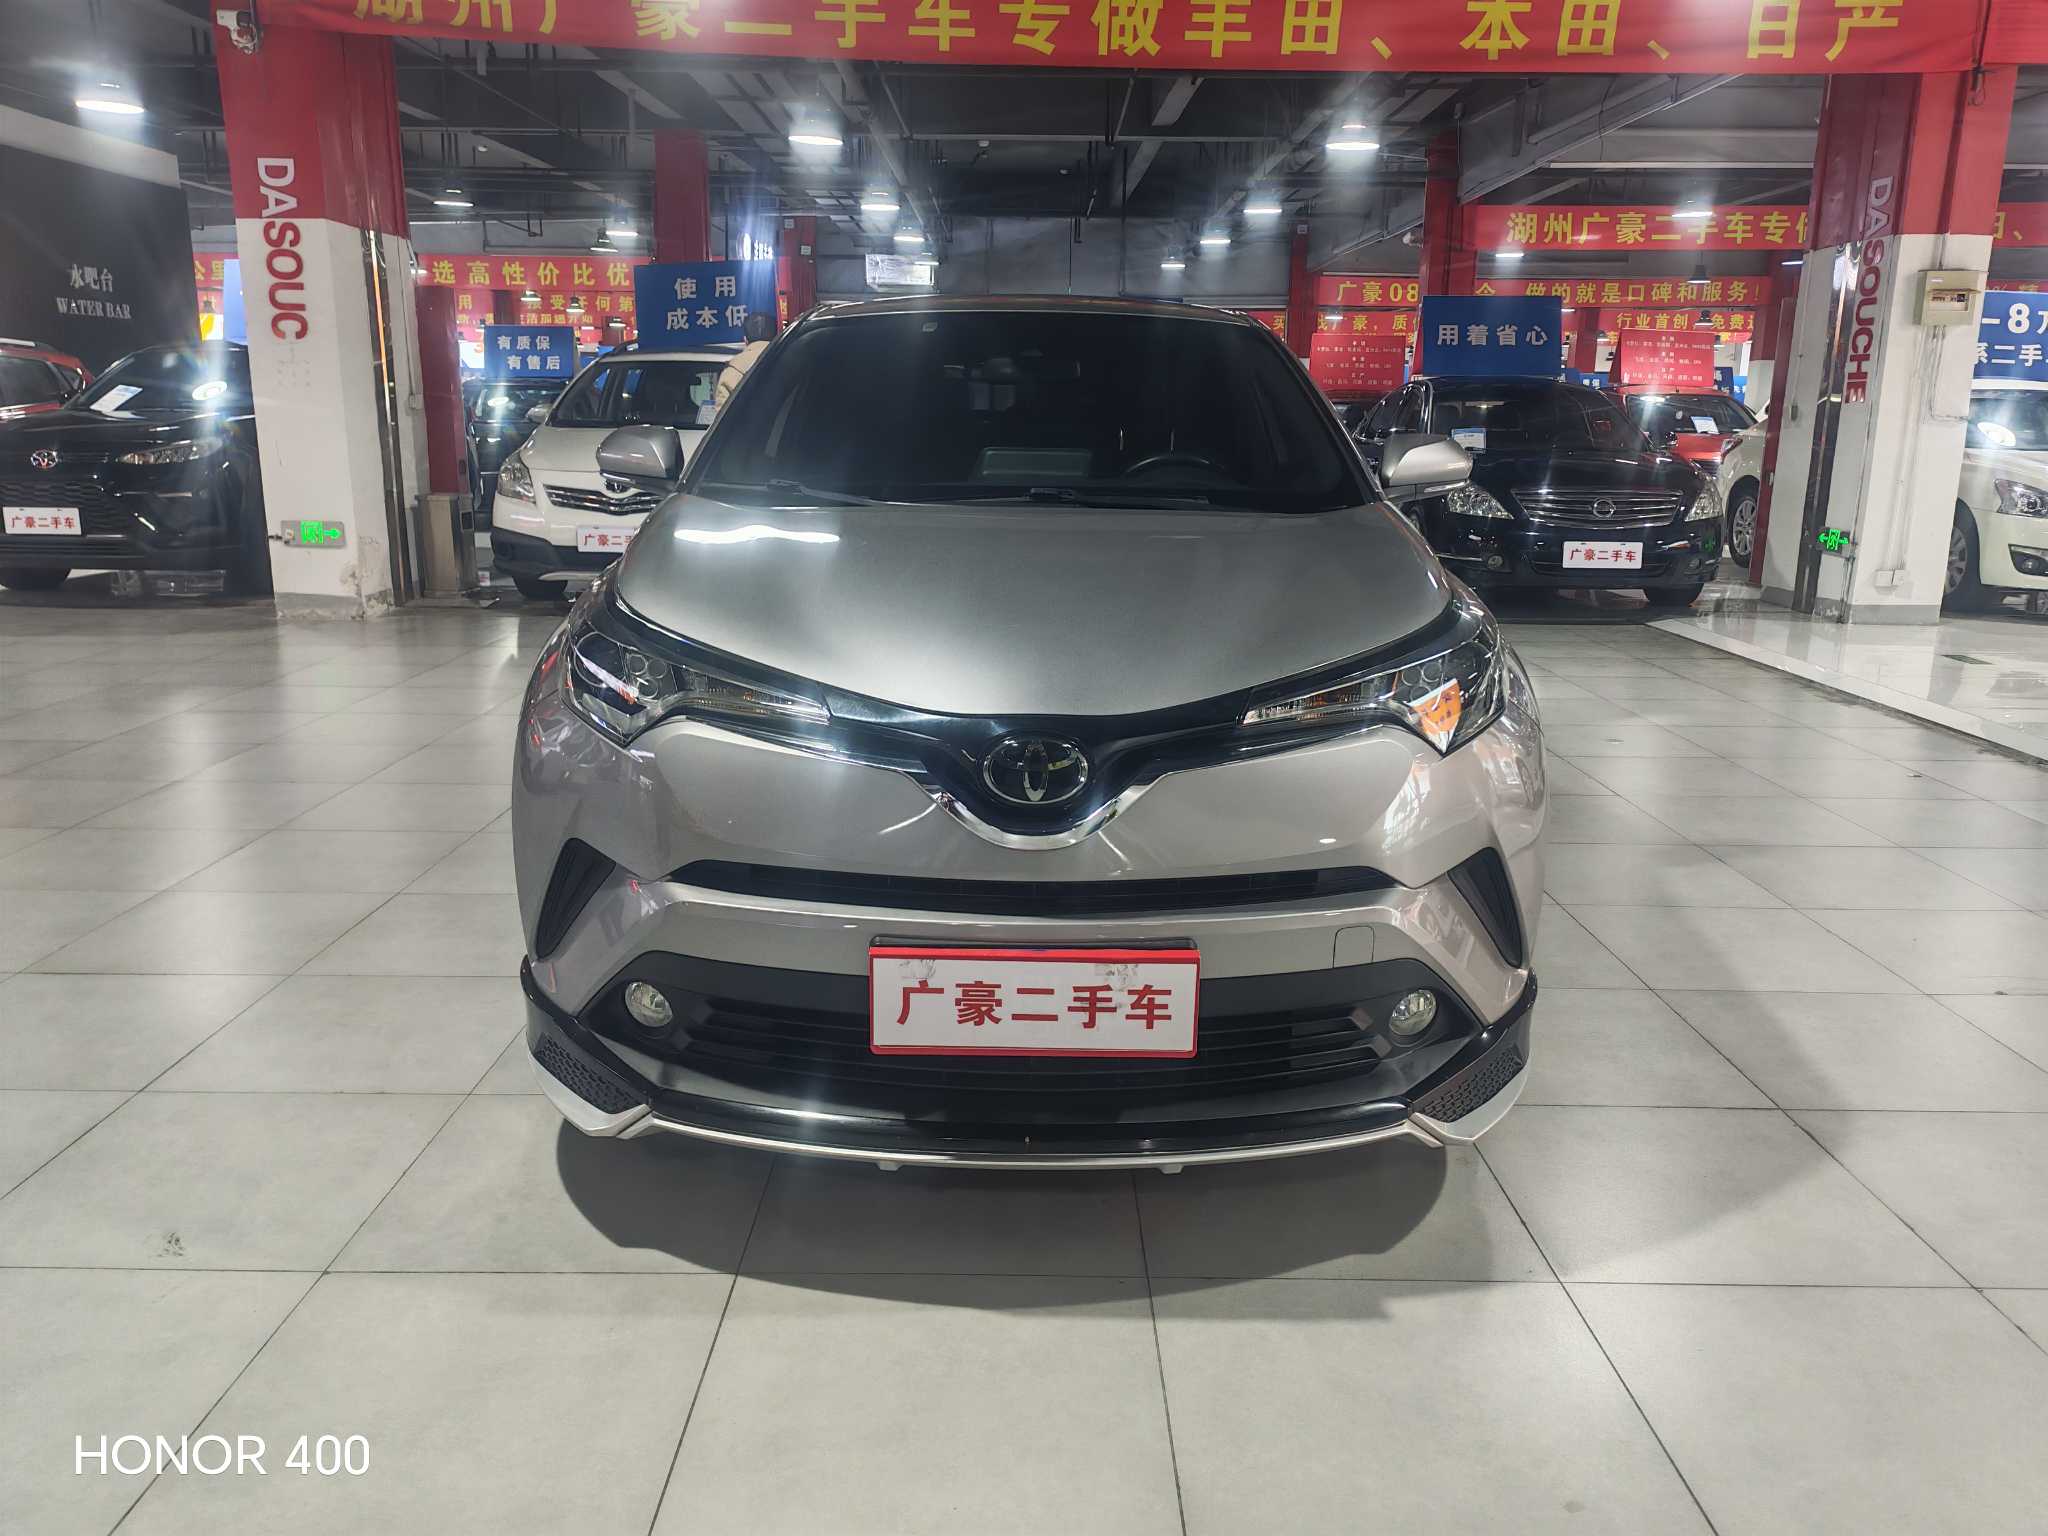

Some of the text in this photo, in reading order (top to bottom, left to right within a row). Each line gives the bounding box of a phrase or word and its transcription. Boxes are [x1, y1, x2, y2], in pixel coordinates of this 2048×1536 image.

[257, 157, 309, 340] DASOUC
[70, 263, 113, 292] 水吧台
[674, 275, 737, 300] 使用
[56, 297, 132, 319] WATER BAR
[666, 304, 748, 330] 成本低
[1437, 324, 1548, 346] 用着省心
[1570, 548, 1637, 563] 广豪二手车
[896, 979, 1173, 1030] 广豪二手车
